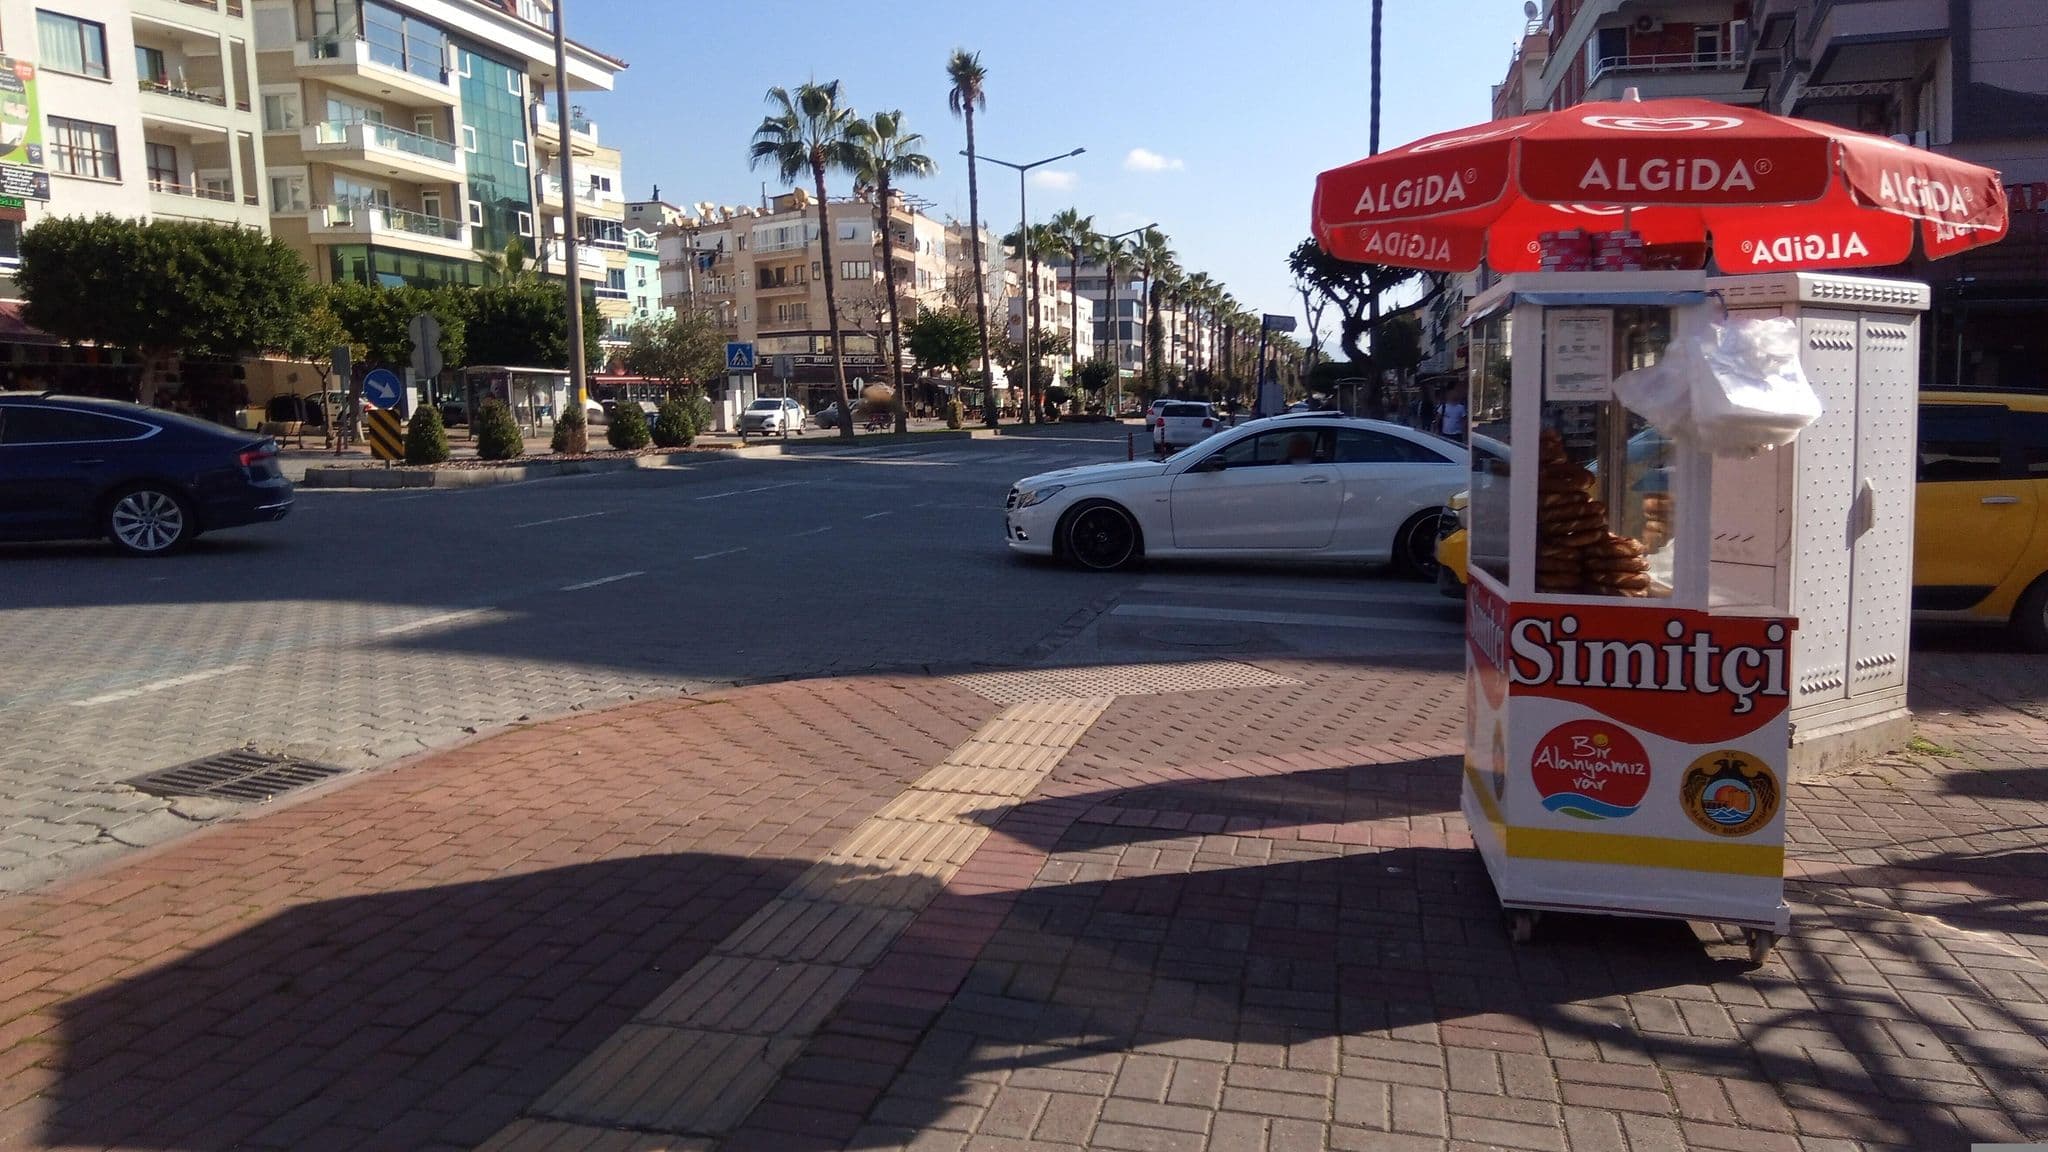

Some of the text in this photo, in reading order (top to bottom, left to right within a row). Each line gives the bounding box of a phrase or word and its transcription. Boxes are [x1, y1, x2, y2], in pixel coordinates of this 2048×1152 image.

[1509, 615, 1788, 714] Simitçi
[1571, 735, 1612, 759] Bir
[1573, 778, 1607, 791] var
